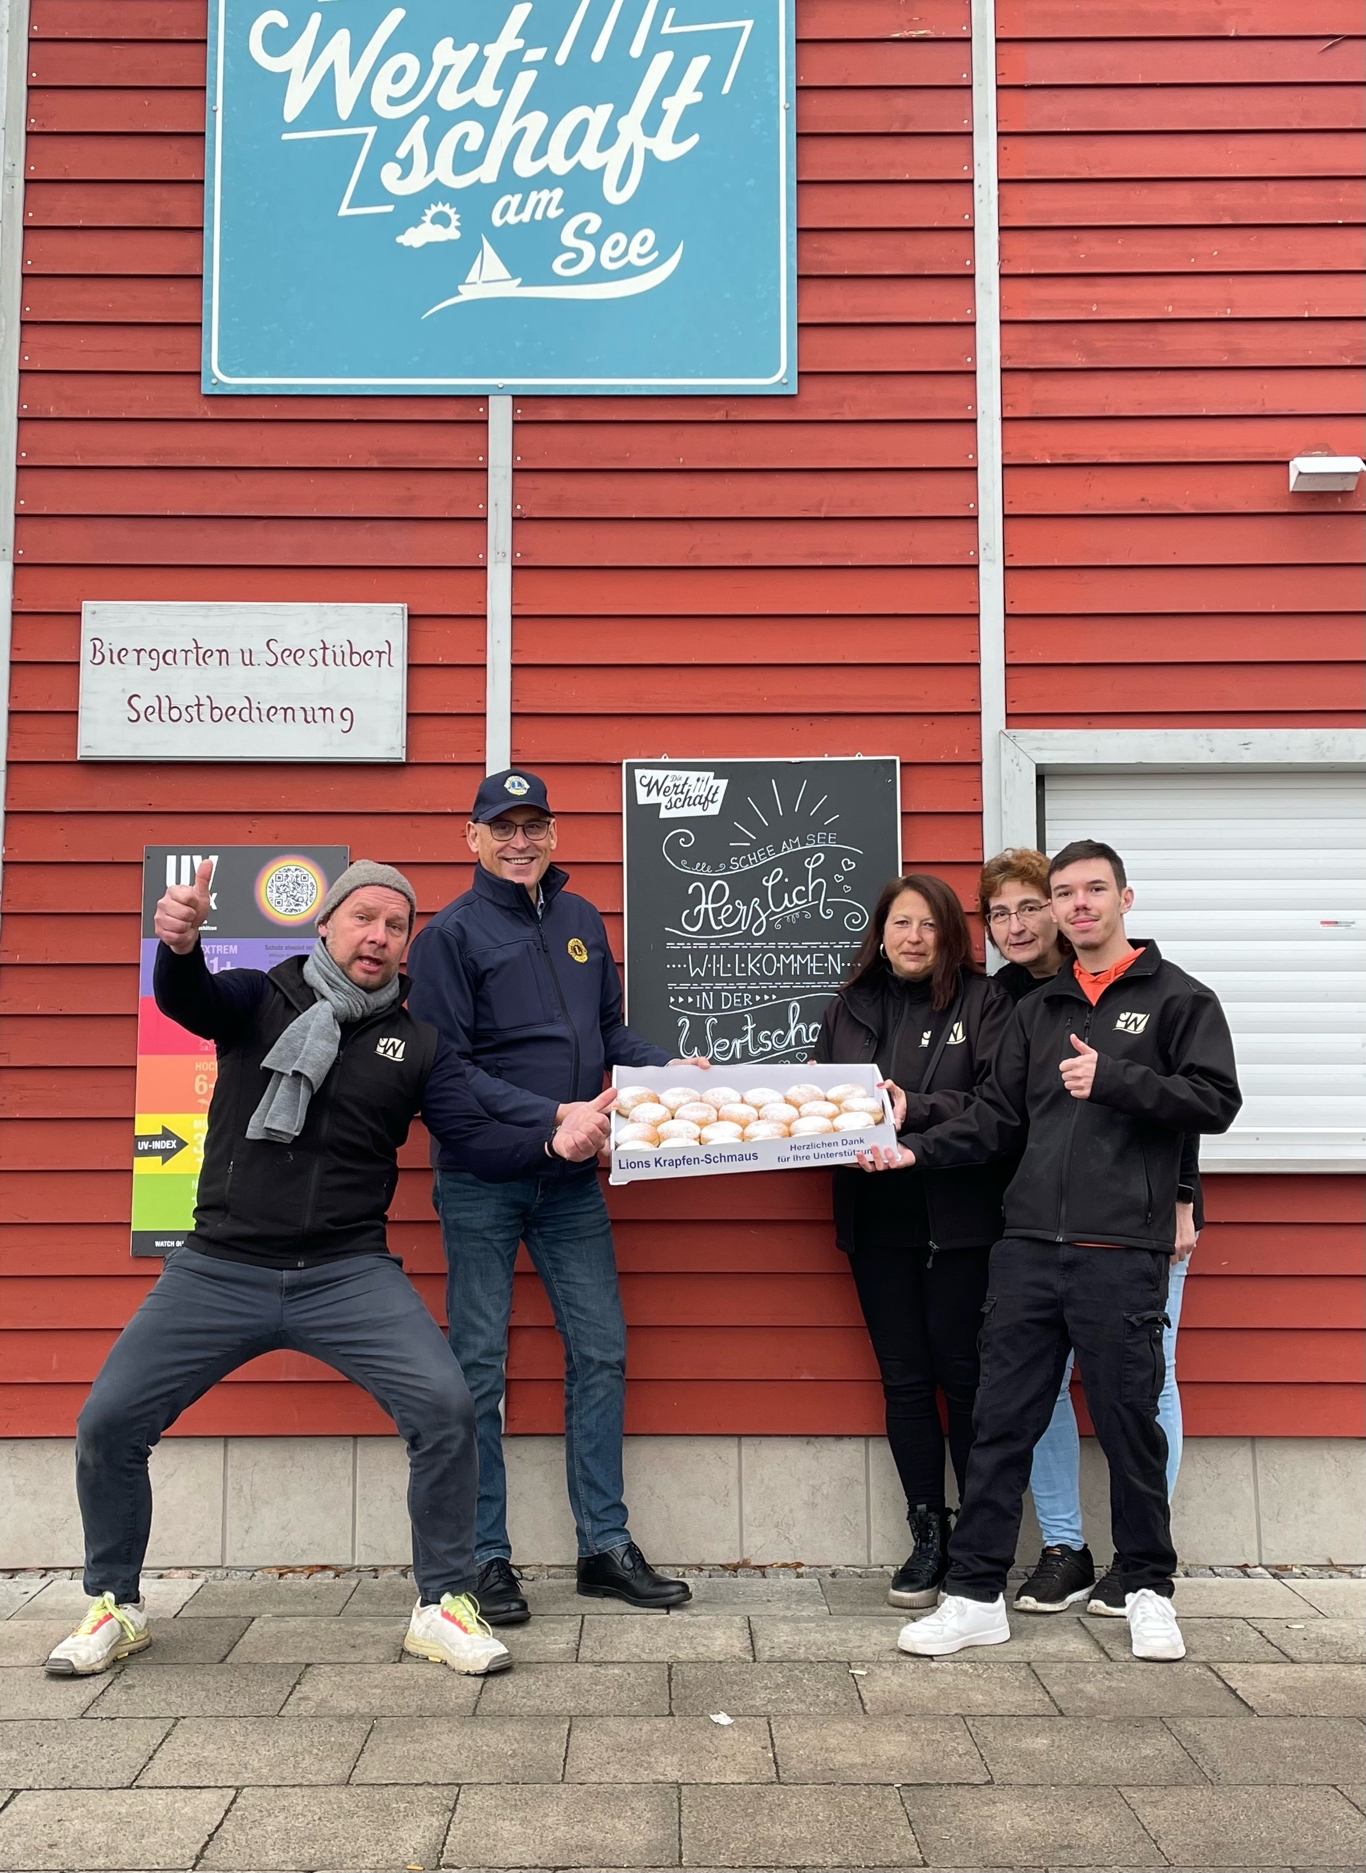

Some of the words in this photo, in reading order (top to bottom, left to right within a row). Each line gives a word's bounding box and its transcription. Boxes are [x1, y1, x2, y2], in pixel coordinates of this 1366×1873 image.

[380, 50, 711, 205] schaft
[491, 187, 565, 227] am
[552, 212, 659, 278] See
[89, 637, 230, 672] Biergarten
[126, 693, 355, 734] Selbstbedienung
[664, 785, 720, 812] schaft
[729, 845, 776, 871] SCHEE
[781, 836, 801, 853] AM
[806, 832, 838, 846] SEE
[681, 852, 834, 937] Herzlich
[687, 952, 843, 978] WILLKOMMEN
[696, 991, 714, 1010] IN
[720, 991, 753, 1009] DER
[676, 1001, 822, 1063] Wertscha
[194, 1061, 218, 1071] HOC
[137, 1139, 177, 1151] UV-INDEX
[777, 1154, 791, 1163] für
[792, 1153, 811, 1162] Ihre
[789, 1141, 839, 1152] Herzlichen
[841, 1137, 865, 1147] Dank
[617, 1158, 651, 1170] Lions
[653, 1151, 759, 1169] Krapfen-Schmaus
[154, 1240, 175, 1248] WATCH
